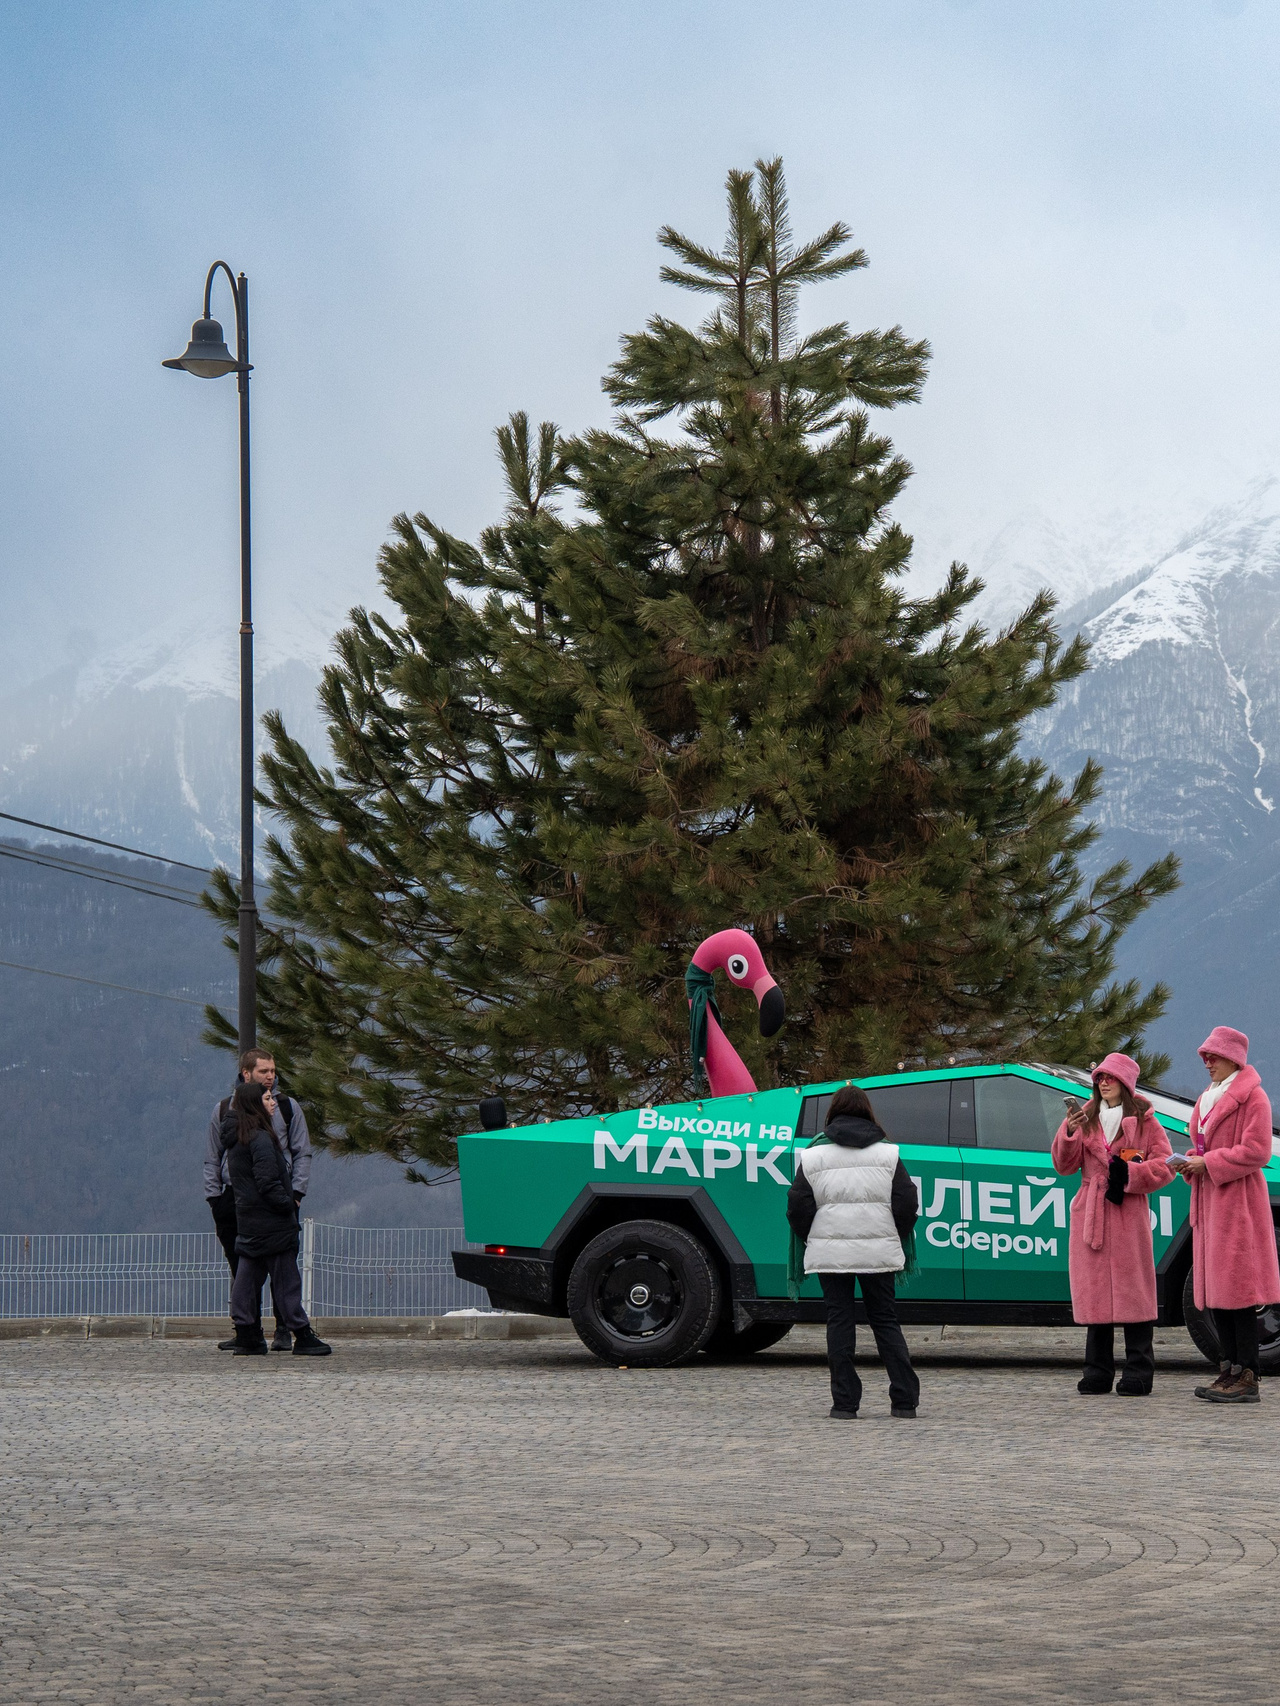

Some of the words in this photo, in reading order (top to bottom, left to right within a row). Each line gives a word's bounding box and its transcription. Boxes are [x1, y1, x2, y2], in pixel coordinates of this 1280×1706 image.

[637, 1108, 751, 1140] Выходи
[758, 1123, 793, 1142] на
[925, 1221, 1058, 1259] Сбером
